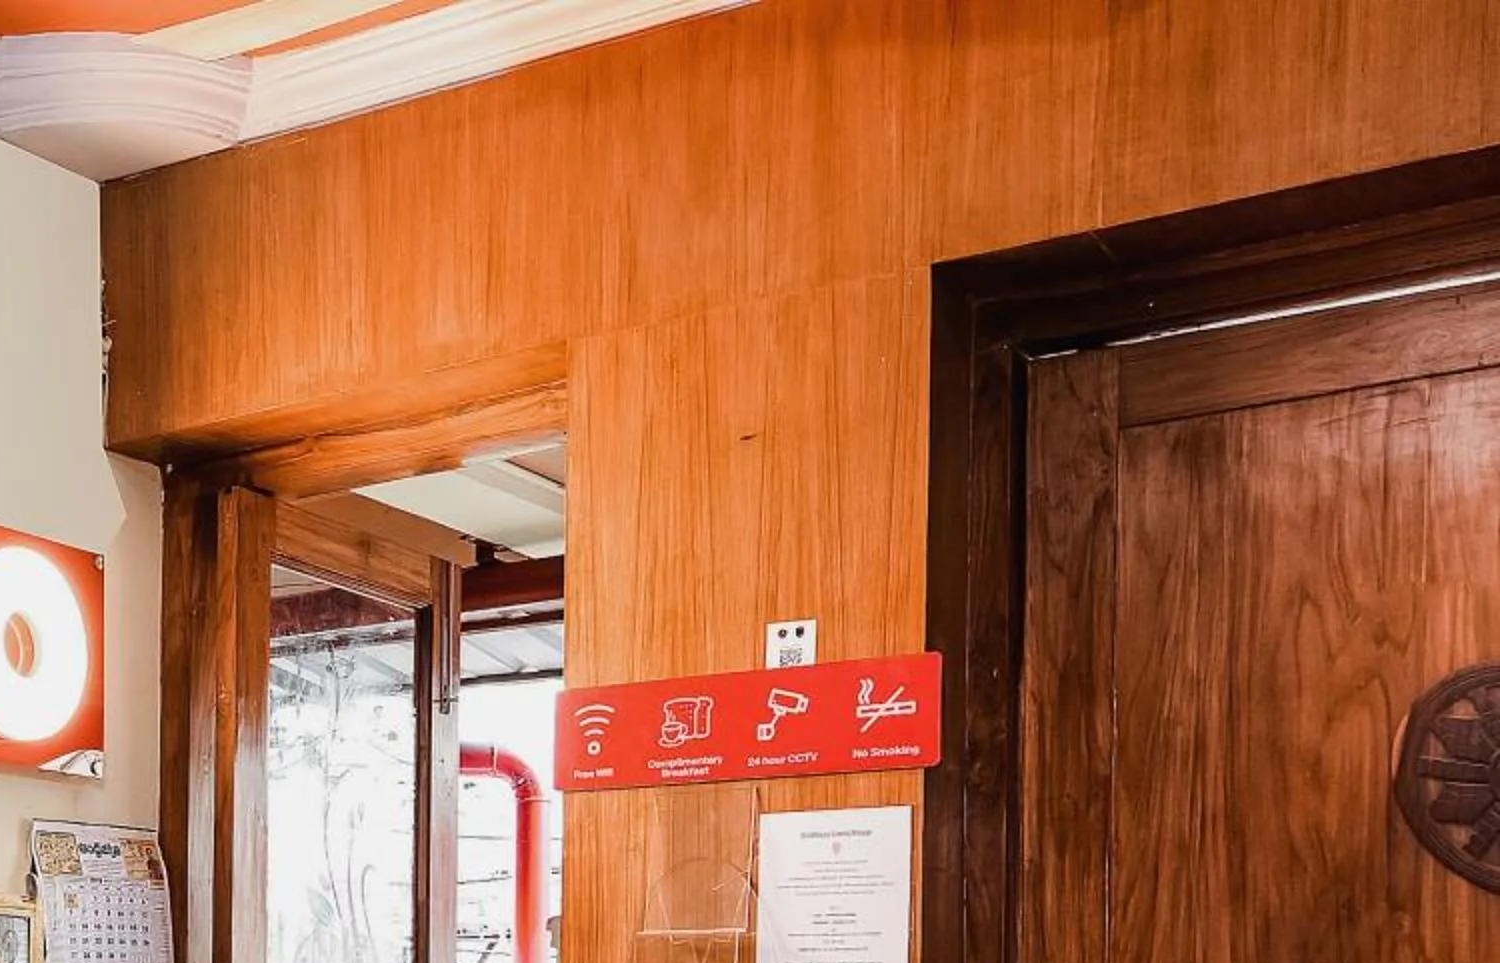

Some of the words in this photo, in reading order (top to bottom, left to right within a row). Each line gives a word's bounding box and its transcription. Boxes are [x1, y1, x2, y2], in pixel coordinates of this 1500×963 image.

[747, 757, 761, 767] 24
[787, 751, 819, 764] CCTV
[852, 749, 869, 759] No
[869, 745, 921, 758] Smoking
[647, 755, 723, 769] Complimentary
[661, 766, 709, 778] Breakfast
